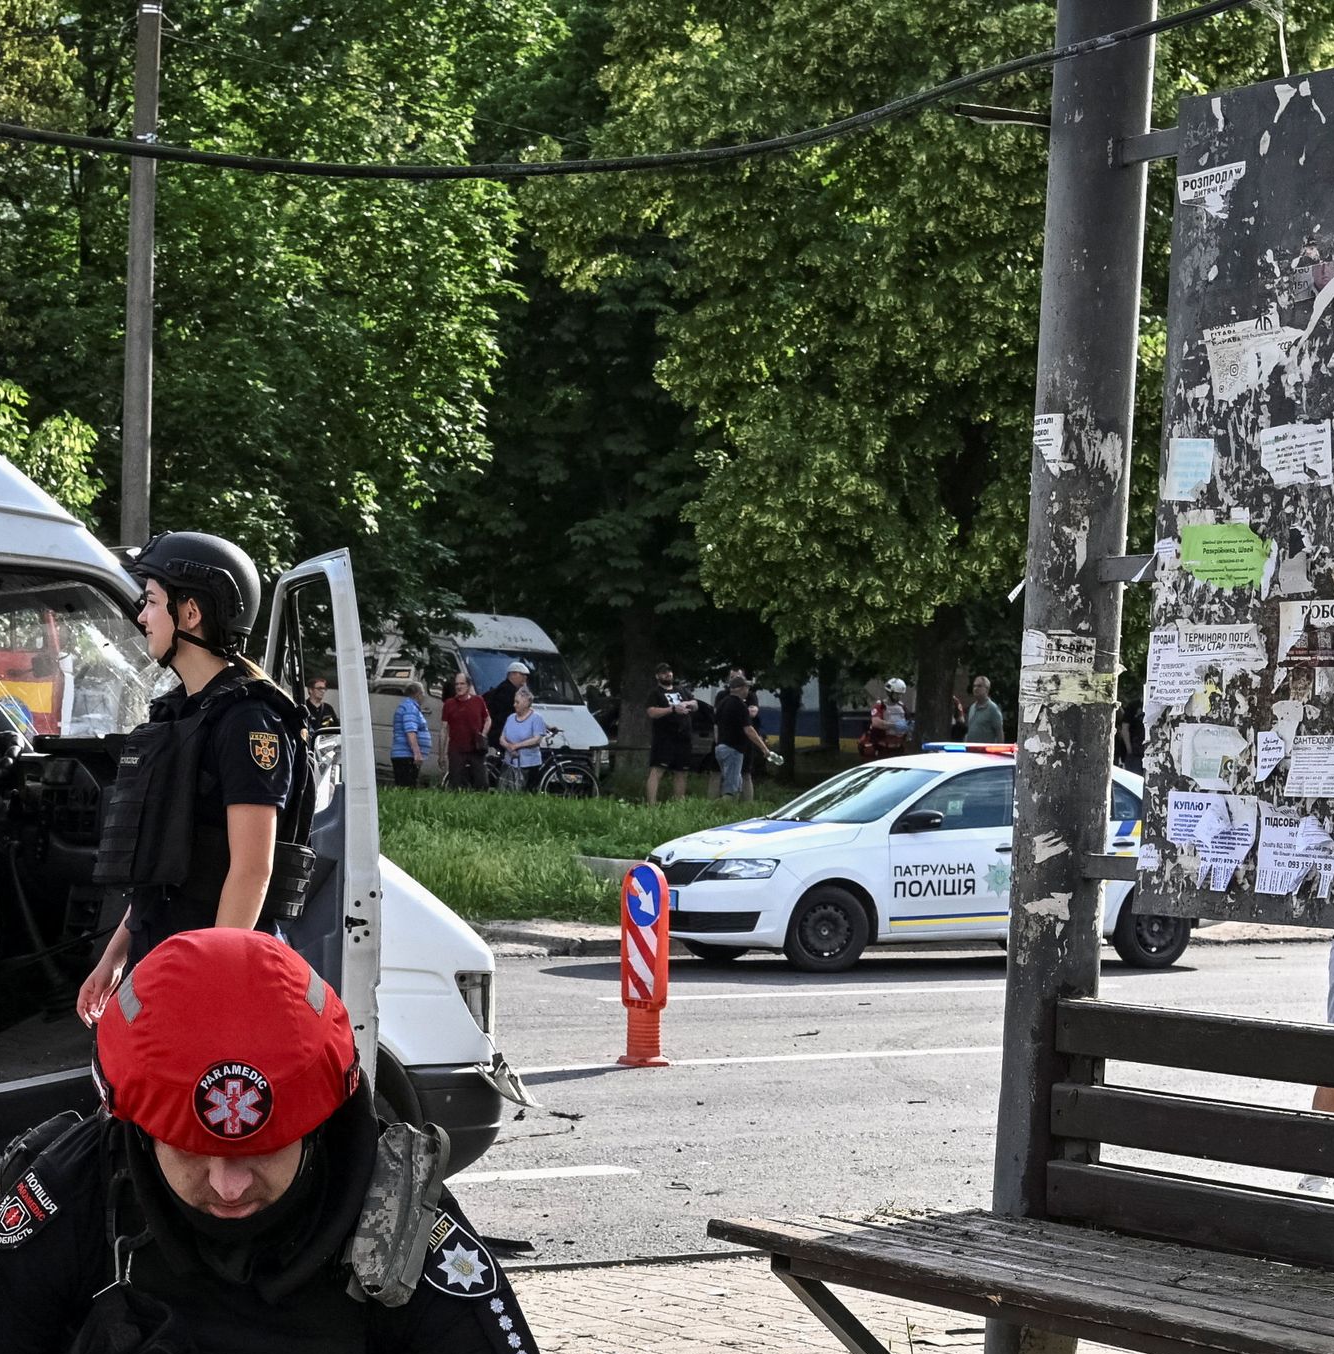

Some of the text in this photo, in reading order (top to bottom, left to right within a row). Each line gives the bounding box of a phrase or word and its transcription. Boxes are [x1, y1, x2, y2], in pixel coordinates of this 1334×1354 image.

[1153, 633, 1176, 646] ПРОДАМ
[1173, 801, 1205, 812] КУПЛЮ
[893, 863, 975, 877] ПАТРУЛЬНА
[1273, 859, 1332, 872] Тел. 093 88
[893, 878, 976, 898] ПОЛІЦІЯ
[200, 1064, 268, 1090] PARAMEDIC
[25, 1172, 58, 1215] ПОЛІЦІЯ
